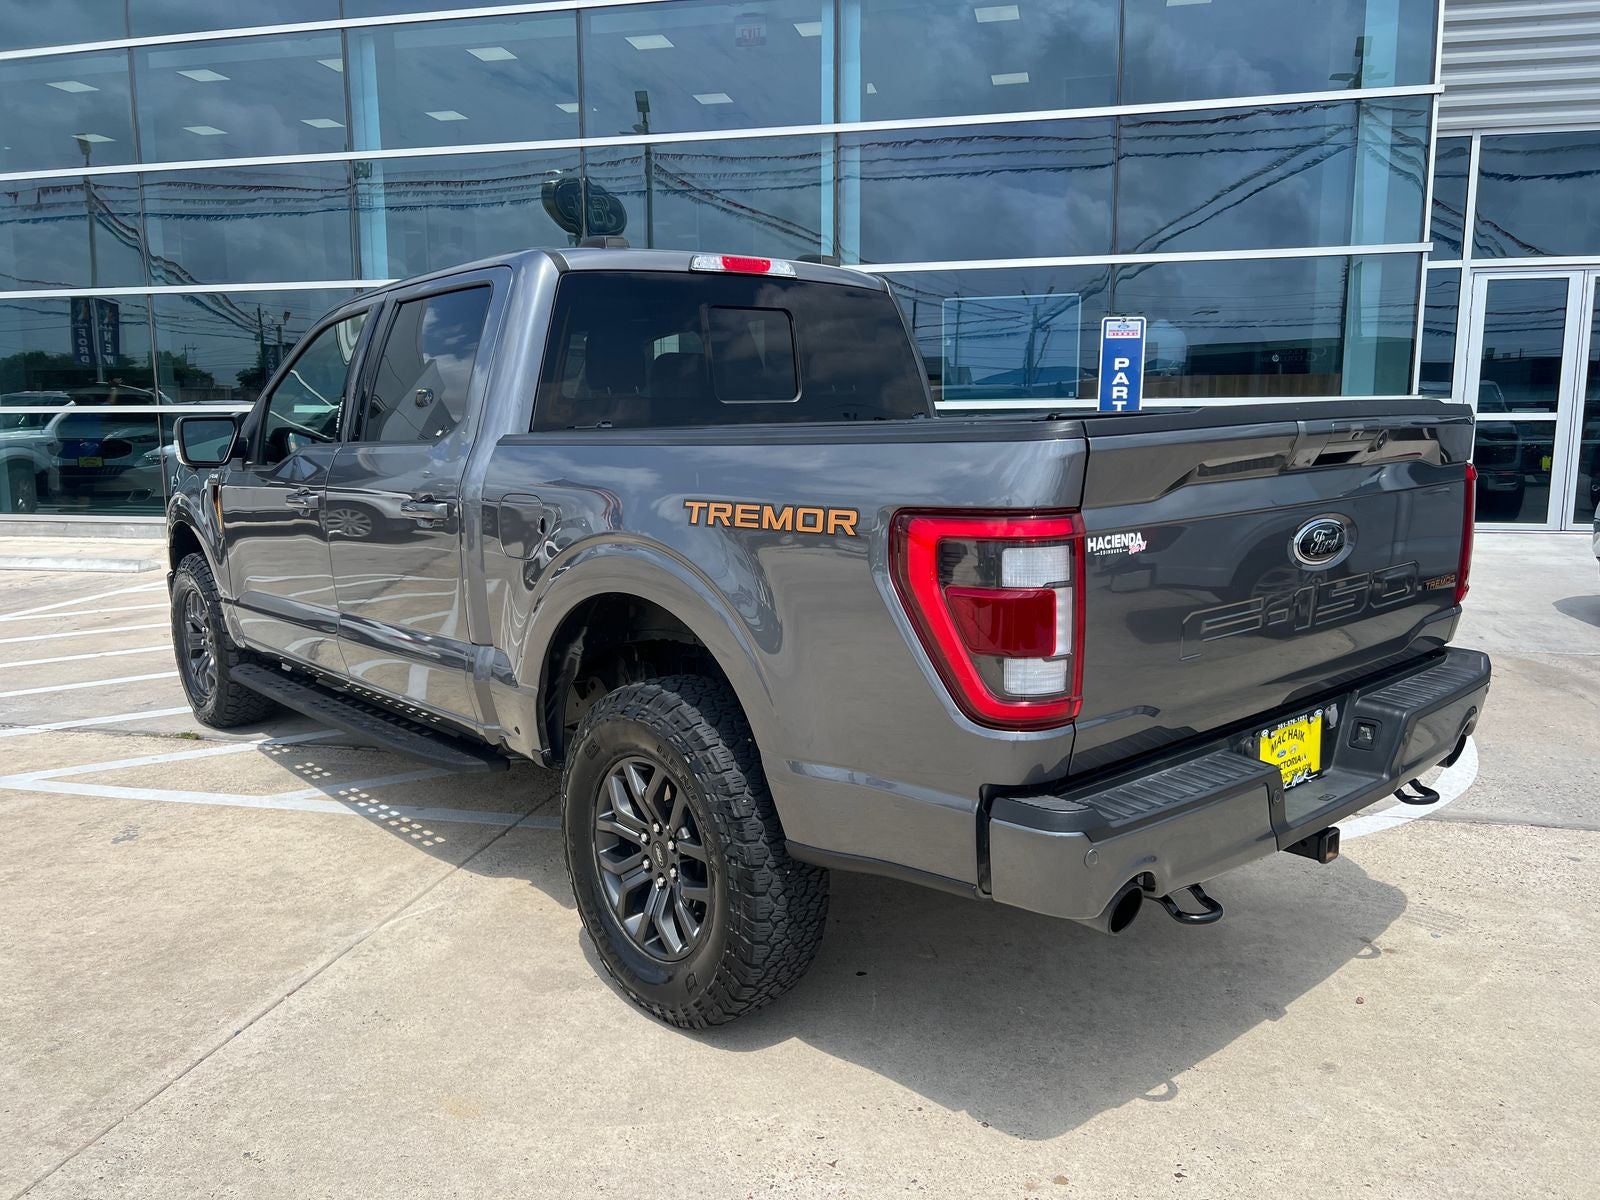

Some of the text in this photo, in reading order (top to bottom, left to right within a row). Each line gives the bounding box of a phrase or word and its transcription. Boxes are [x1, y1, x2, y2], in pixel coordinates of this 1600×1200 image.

[685, 500, 858, 536] TREMOR
[1087, 532, 1142, 552] HACIENDA
[1310, 528, 1340, 556] Ford
[1179, 560, 1419, 661] F-150
[1271, 728, 1305, 756] MAC HAIK
